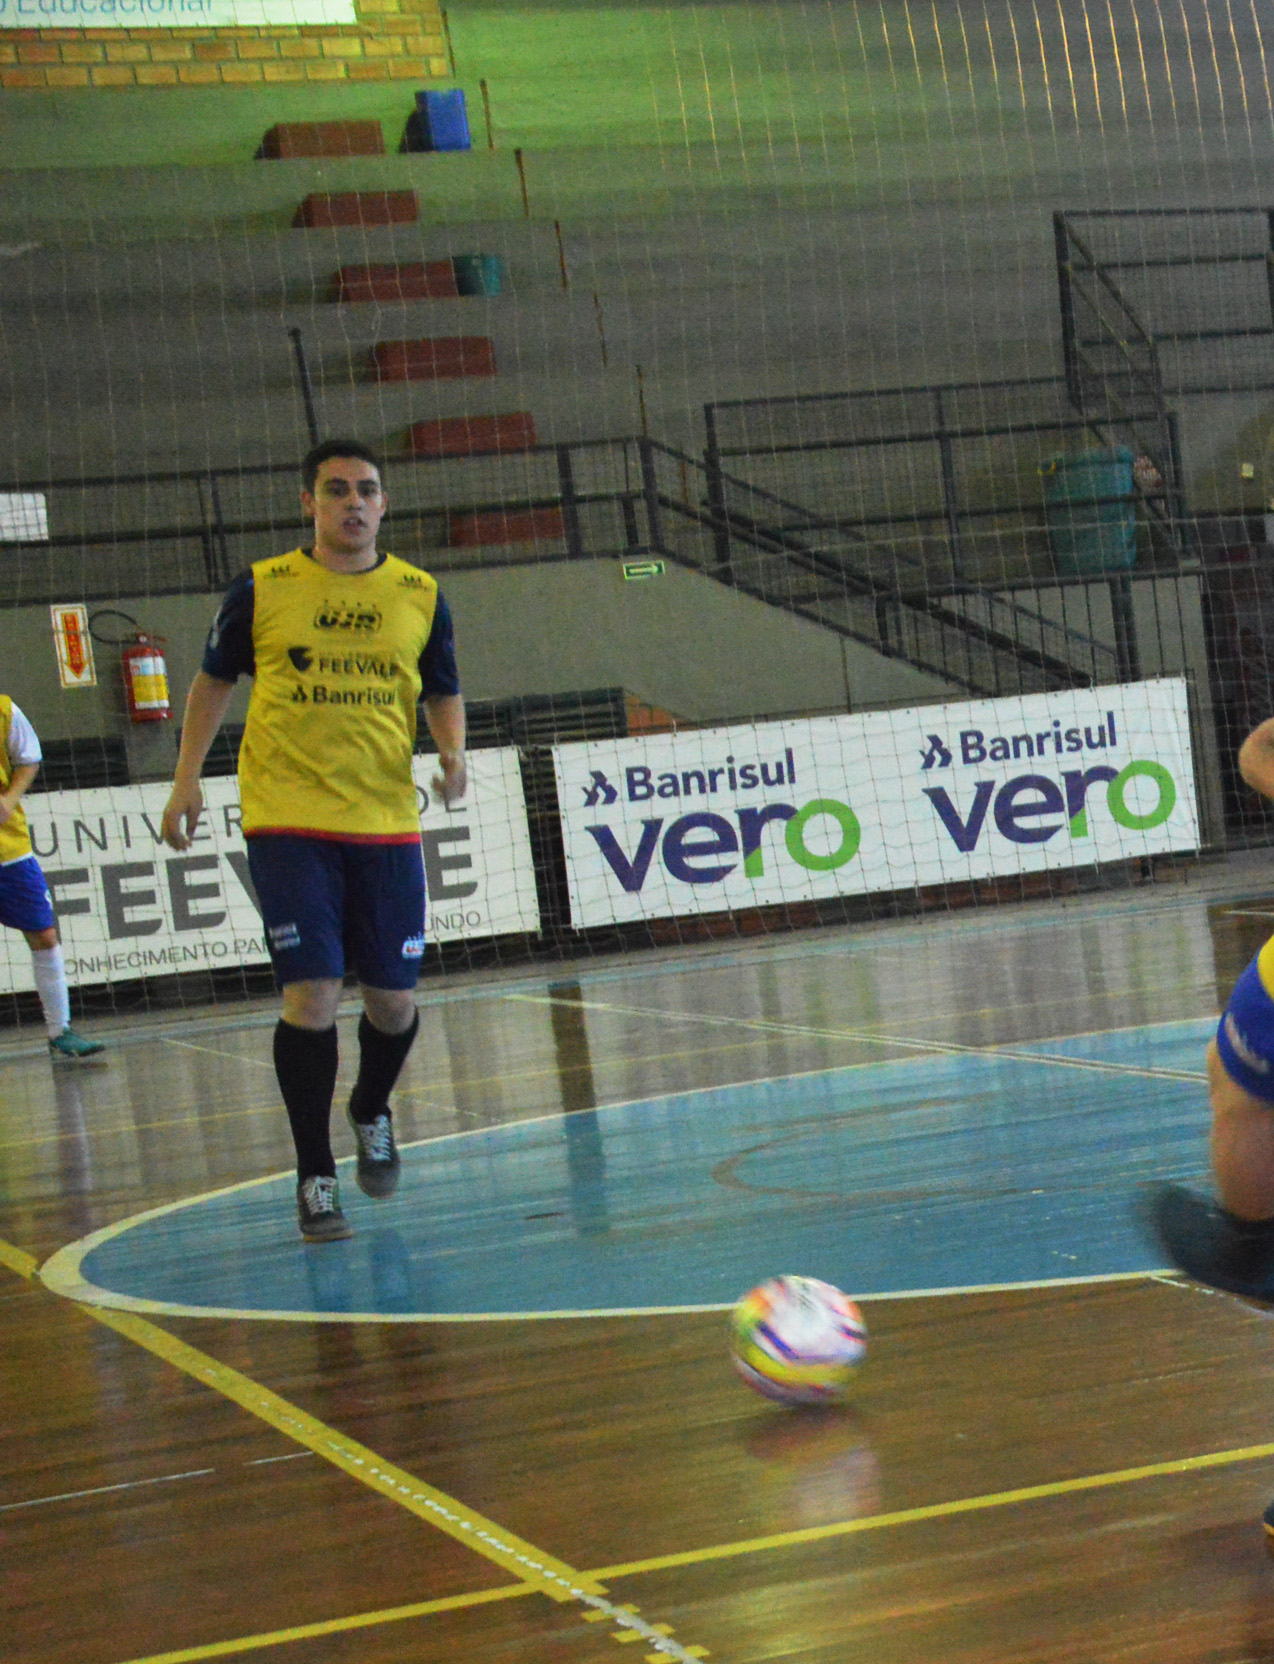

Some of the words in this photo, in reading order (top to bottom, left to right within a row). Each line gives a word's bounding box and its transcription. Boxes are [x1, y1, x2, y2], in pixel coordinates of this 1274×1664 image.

[958, 710, 1117, 766] Banrisul
[625, 746, 797, 803] Banrisul
[921, 758, 1177, 853] vero
[584, 797, 862, 894] vero
[64, 940, 228, 977] ONHECIMENTO
